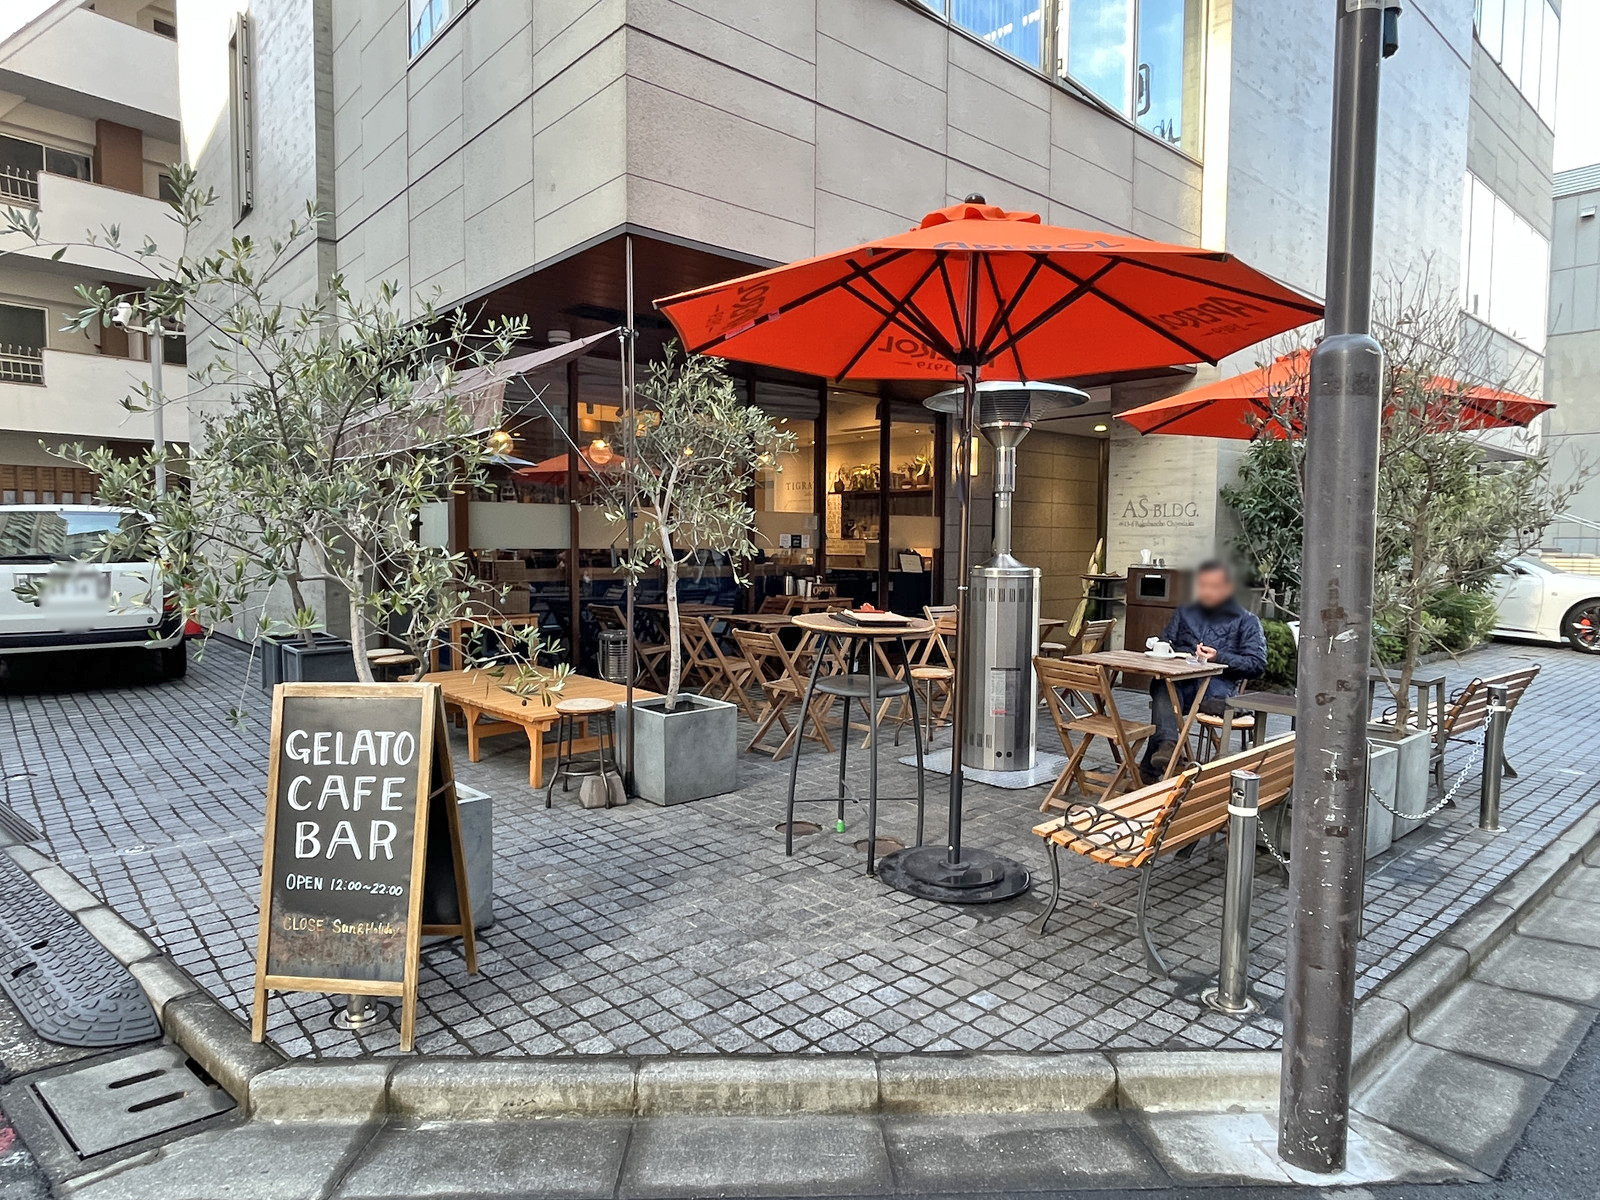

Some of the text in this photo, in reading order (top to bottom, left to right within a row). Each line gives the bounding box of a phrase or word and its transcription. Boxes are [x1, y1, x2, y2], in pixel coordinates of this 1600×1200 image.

[1121, 498, 1199, 518] AS BLDG.
[284, 729, 416, 767] GELATO
[286, 774, 406, 812] CAFE
[294, 819, 398, 861] BAR
[285, 873, 324, 891] OPEN
[282, 916, 325, 933] CLOSE
